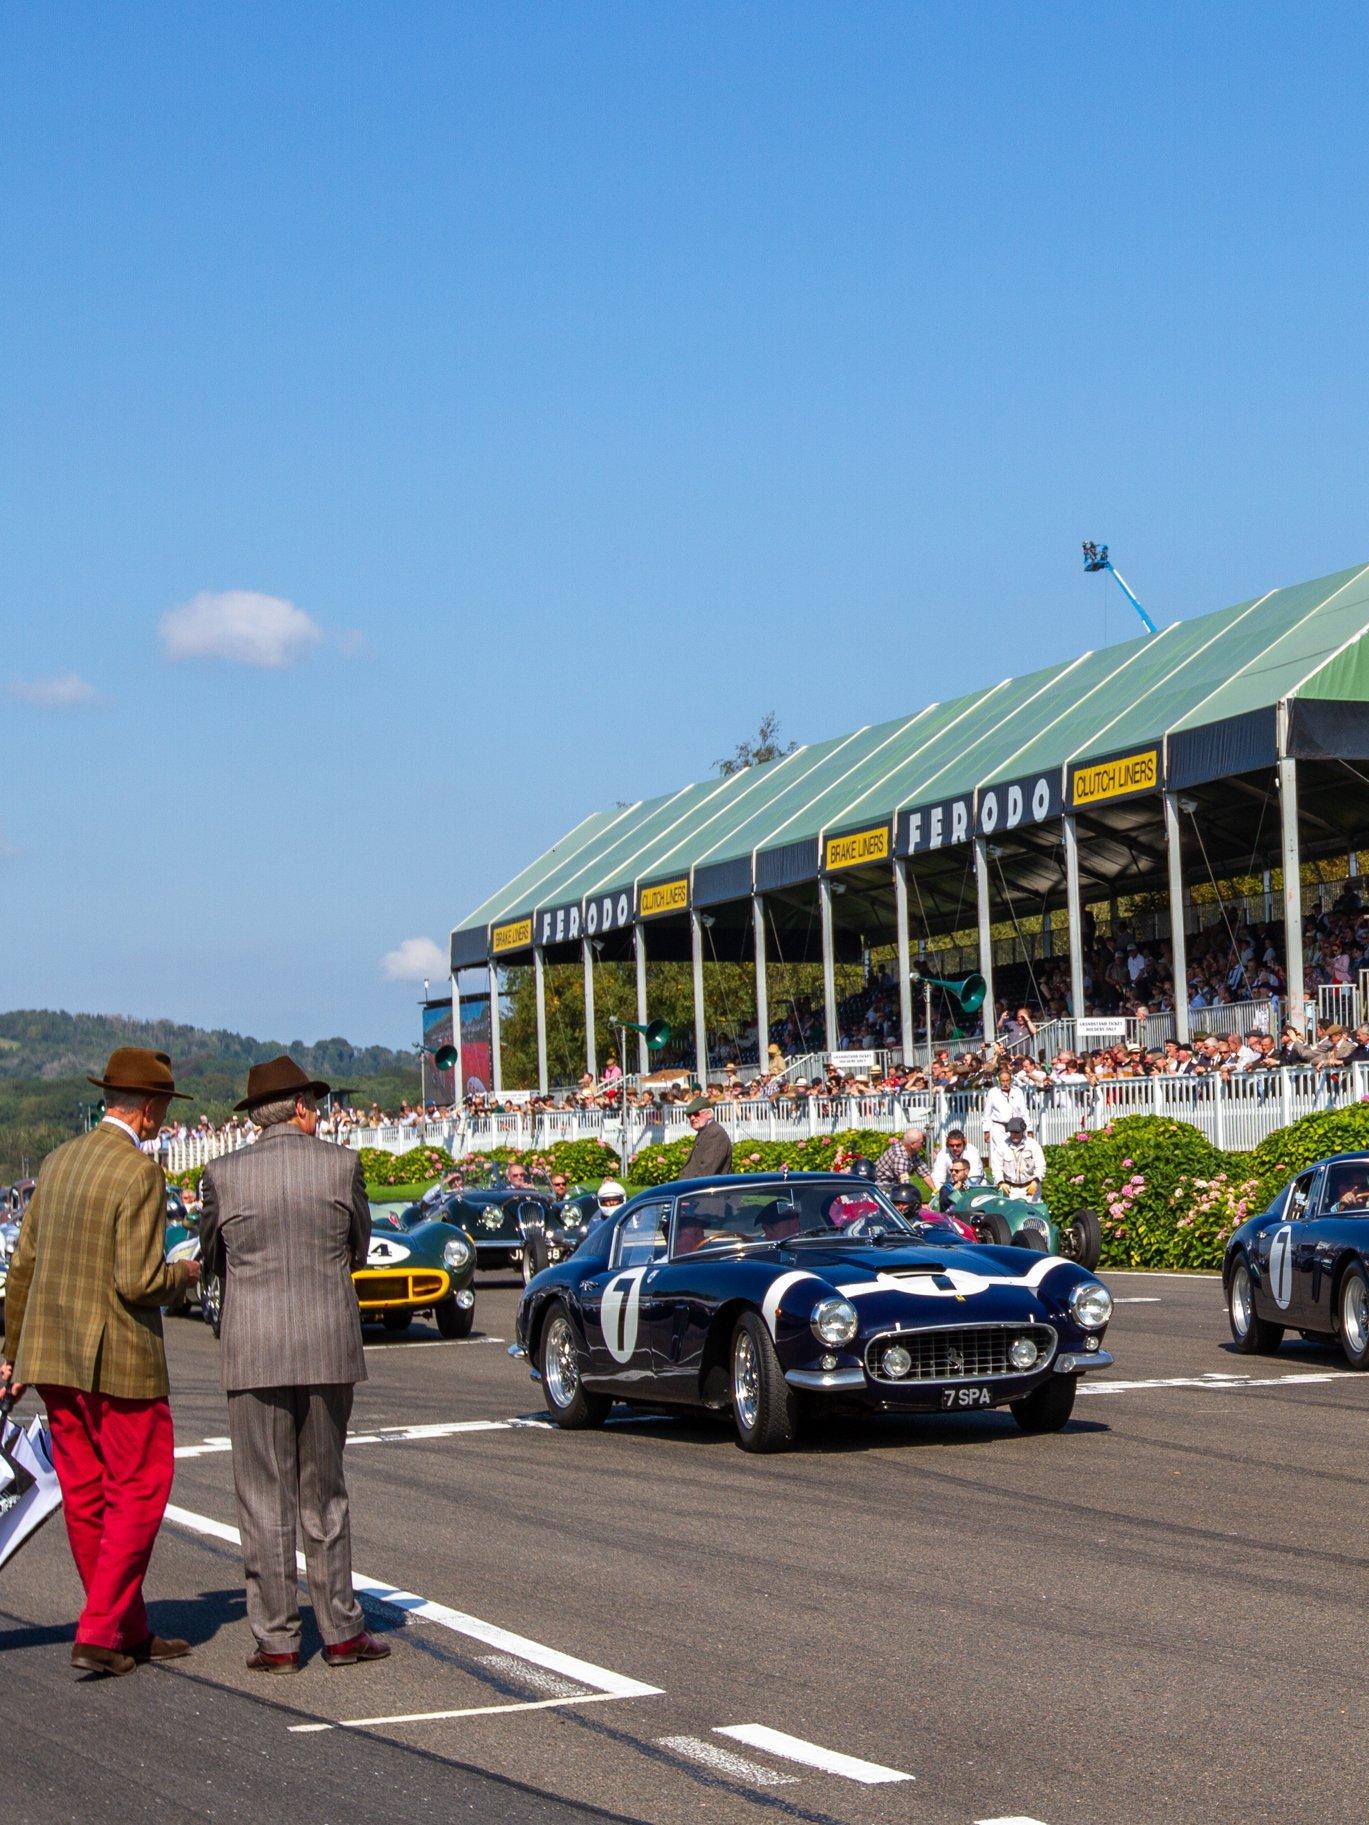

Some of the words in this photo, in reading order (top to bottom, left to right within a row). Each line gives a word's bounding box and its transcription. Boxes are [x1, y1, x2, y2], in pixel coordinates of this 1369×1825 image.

[1076, 769, 1116, 798] CLUTCH
[1118, 758, 1153, 788] LINERS
[908, 778, 1050, 855] FERODO
[830, 840, 857, 864] BRAKE
[858, 834, 884, 859] LINERS
[642, 889, 666, 911] CLUTCH
[666, 885, 686, 905] LINERS
[495, 930, 512, 948] BRAKE
[512, 924, 529, 943] LINERS
[542, 893, 628, 945] FERODO
[1276, 1231, 1290, 1299] 7
[612, 1278, 636, 1351] 7
[944, 1390, 956, 1406] 7
[958, 1388, 990, 1406] SPA
